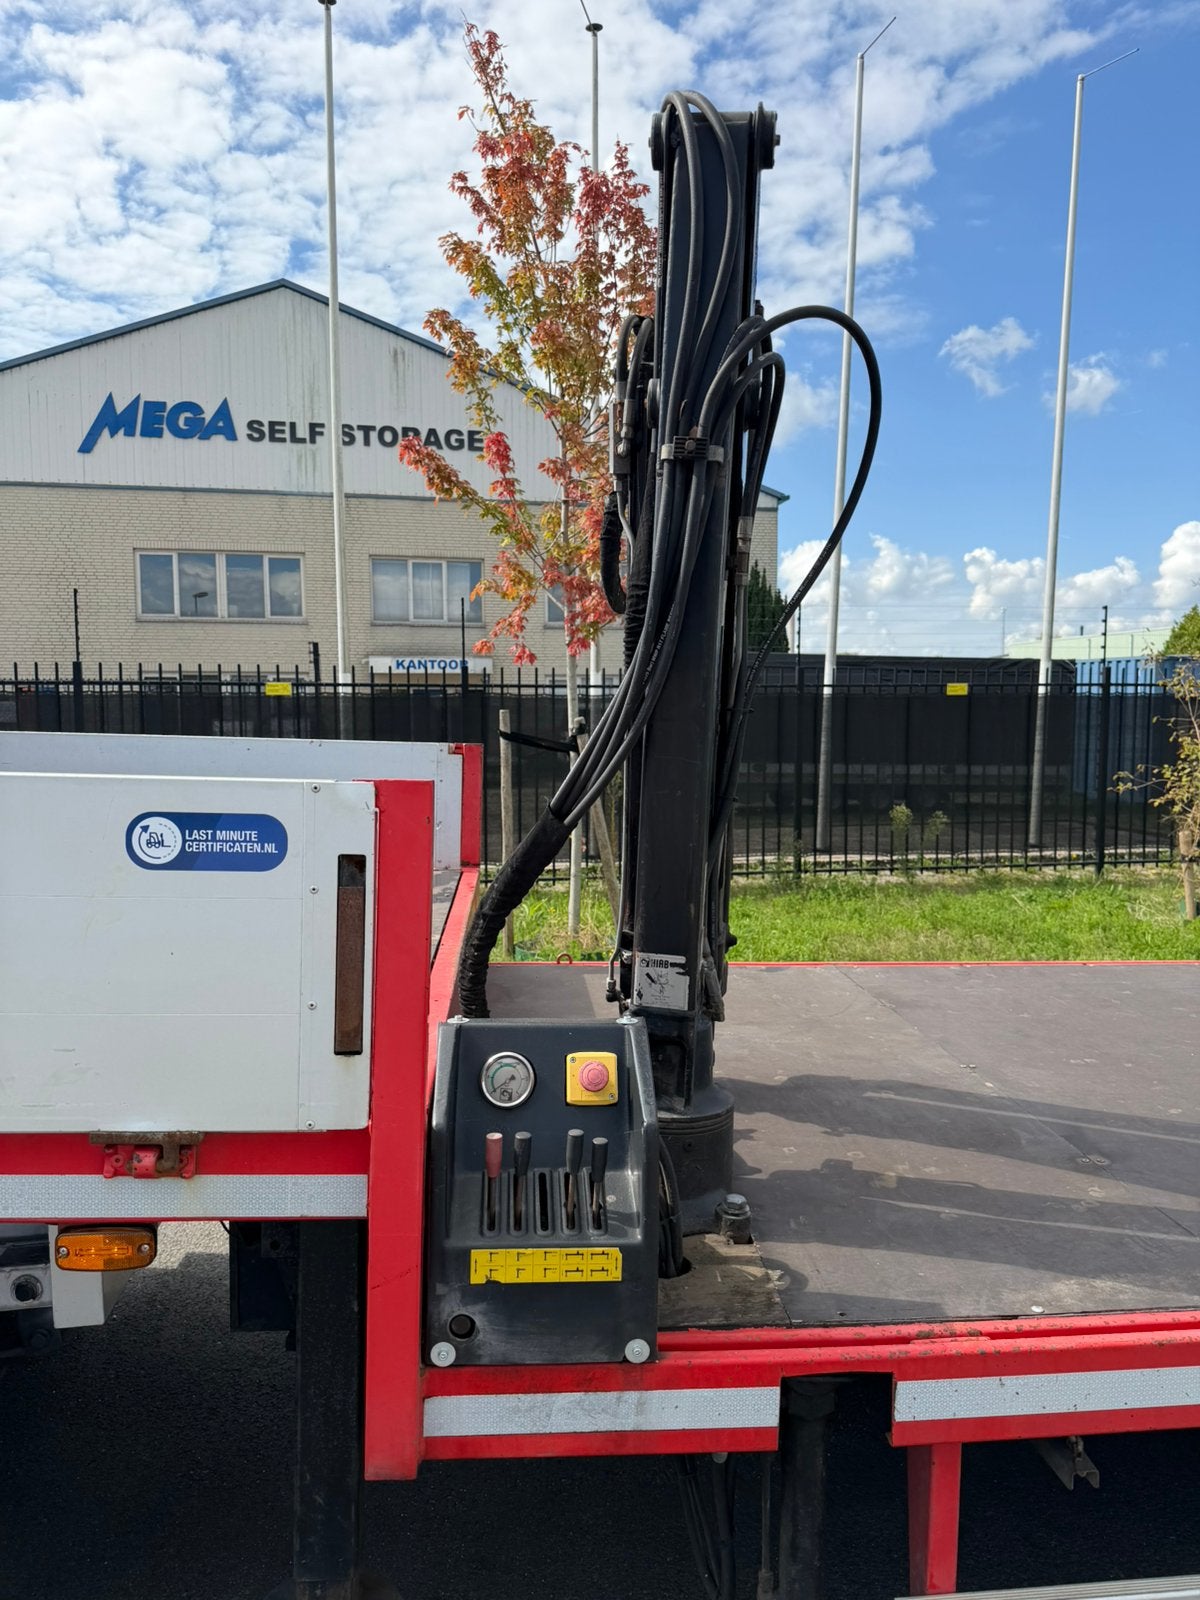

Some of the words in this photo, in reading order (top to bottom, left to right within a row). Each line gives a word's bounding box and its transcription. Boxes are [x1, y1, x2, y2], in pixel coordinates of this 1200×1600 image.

[77, 391, 238, 453] MEGA
[246, 419, 325, 444] SELF
[185, 829, 213, 841] LAST
[216, 830, 258, 842] MINUTE
[185, 841, 278, 854] CERTIFICATEN.NL
